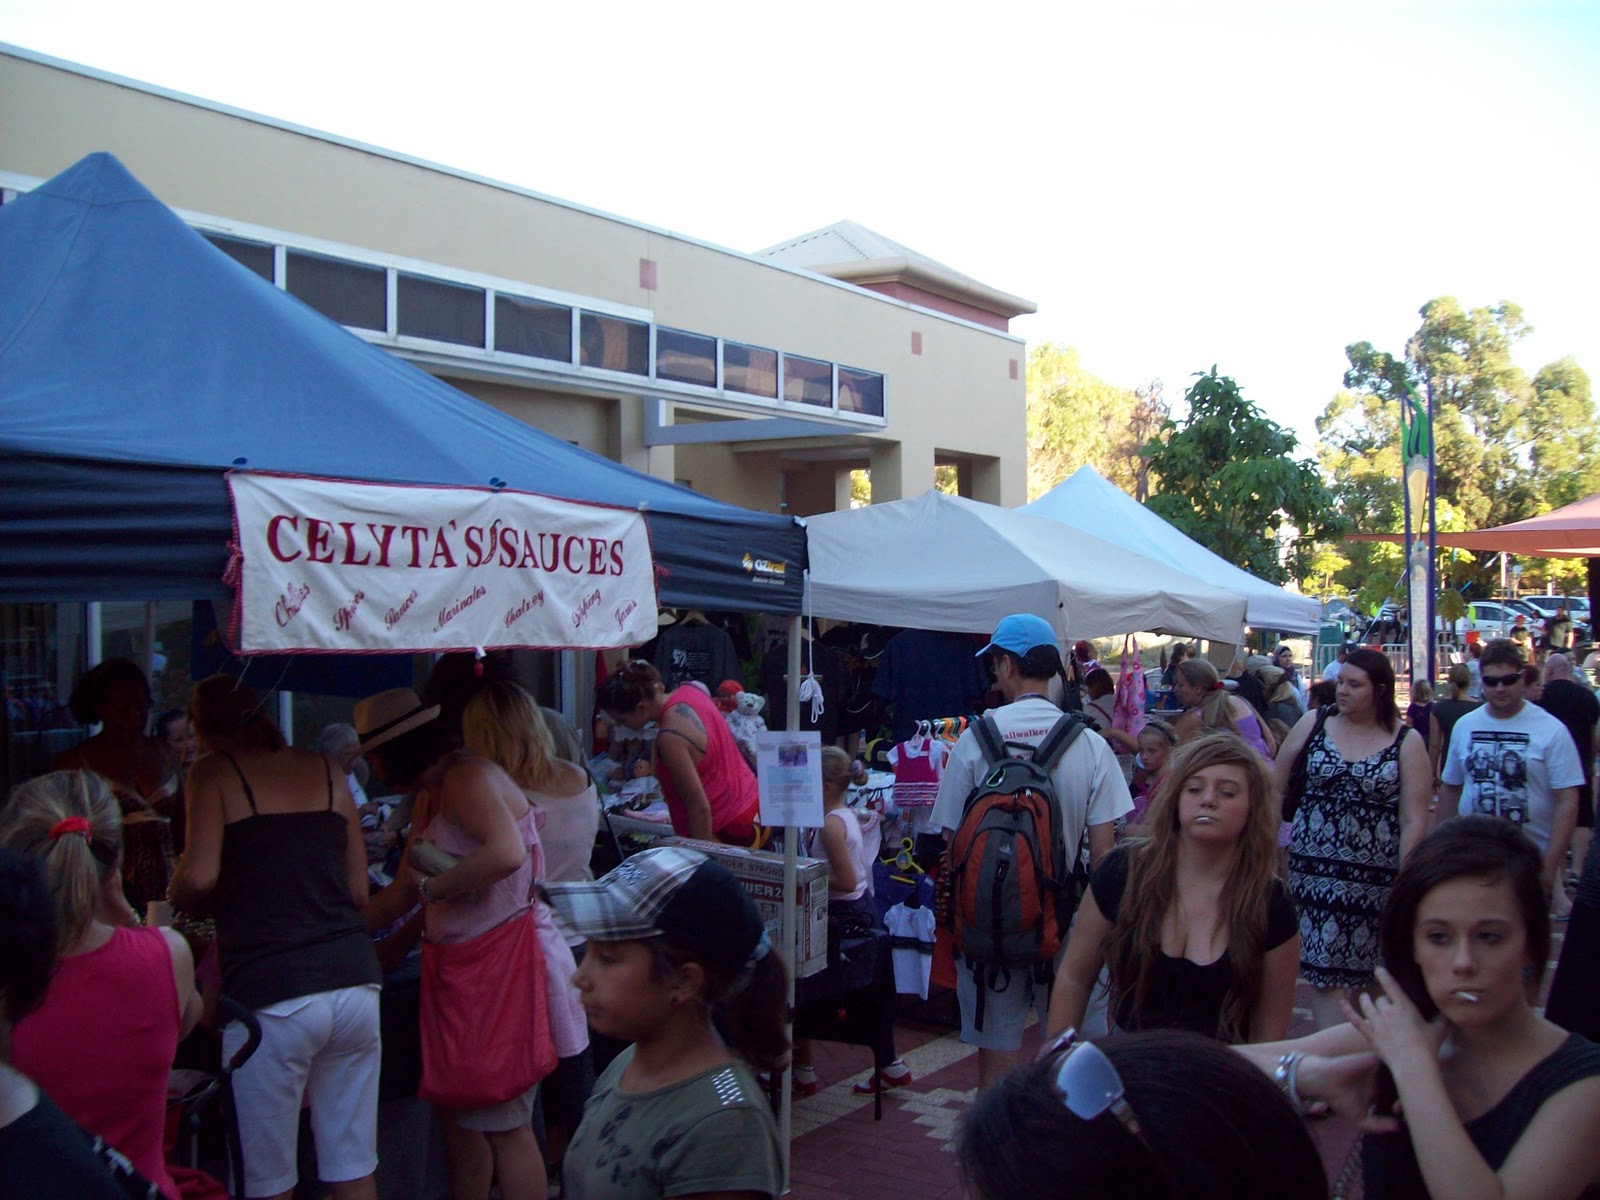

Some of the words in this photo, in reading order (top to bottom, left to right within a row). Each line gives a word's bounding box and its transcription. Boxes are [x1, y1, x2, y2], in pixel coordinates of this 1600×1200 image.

[266, 514, 484, 568] CELYTA'S
[499, 528, 624, 577] SAUCES
[614, 600, 637, 632] Jams
